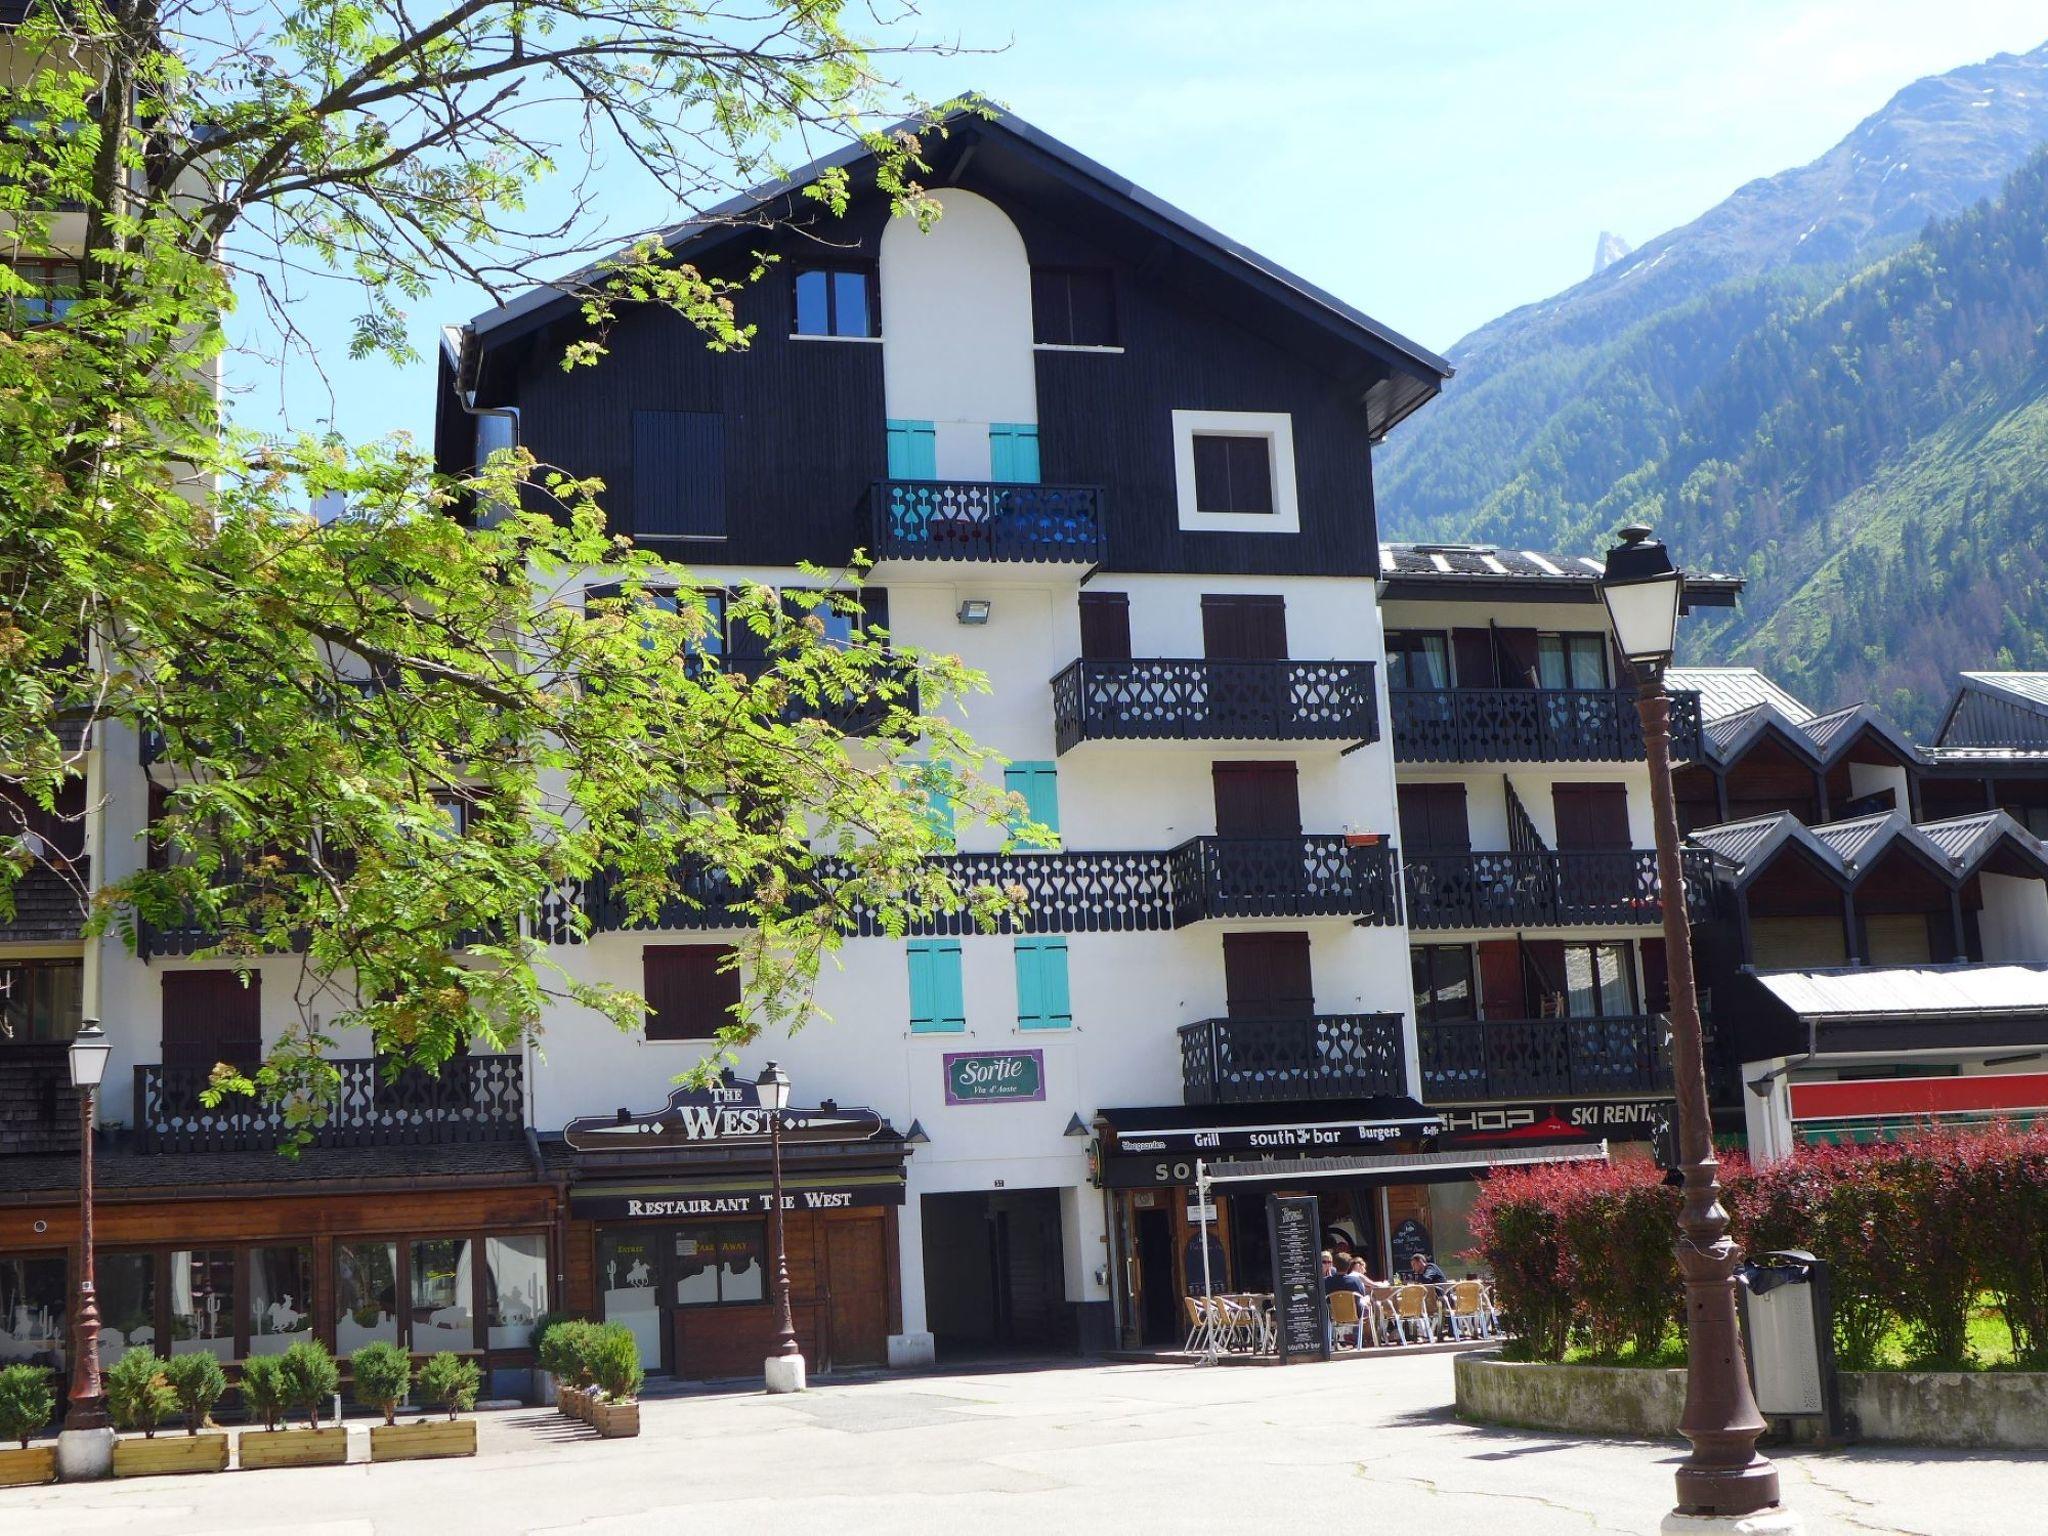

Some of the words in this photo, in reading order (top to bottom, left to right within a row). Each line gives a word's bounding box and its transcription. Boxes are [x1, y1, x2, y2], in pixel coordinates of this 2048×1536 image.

[959, 1057, 1023, 1085] Sortie
[709, 1088, 743, 1104] THE
[677, 1105, 780, 1140] WEST
[1571, 1107, 1598, 1126] SKI
[1194, 1133, 1220, 1147] Grill
[1249, 1130, 1295, 1146] south
[1313, 1129, 1341, 1143] bar
[1358, 1126, 1401, 1141] Burgers
[628, 1197, 750, 1216] RESTAURANT
[804, 1192, 852, 1208] WEST
